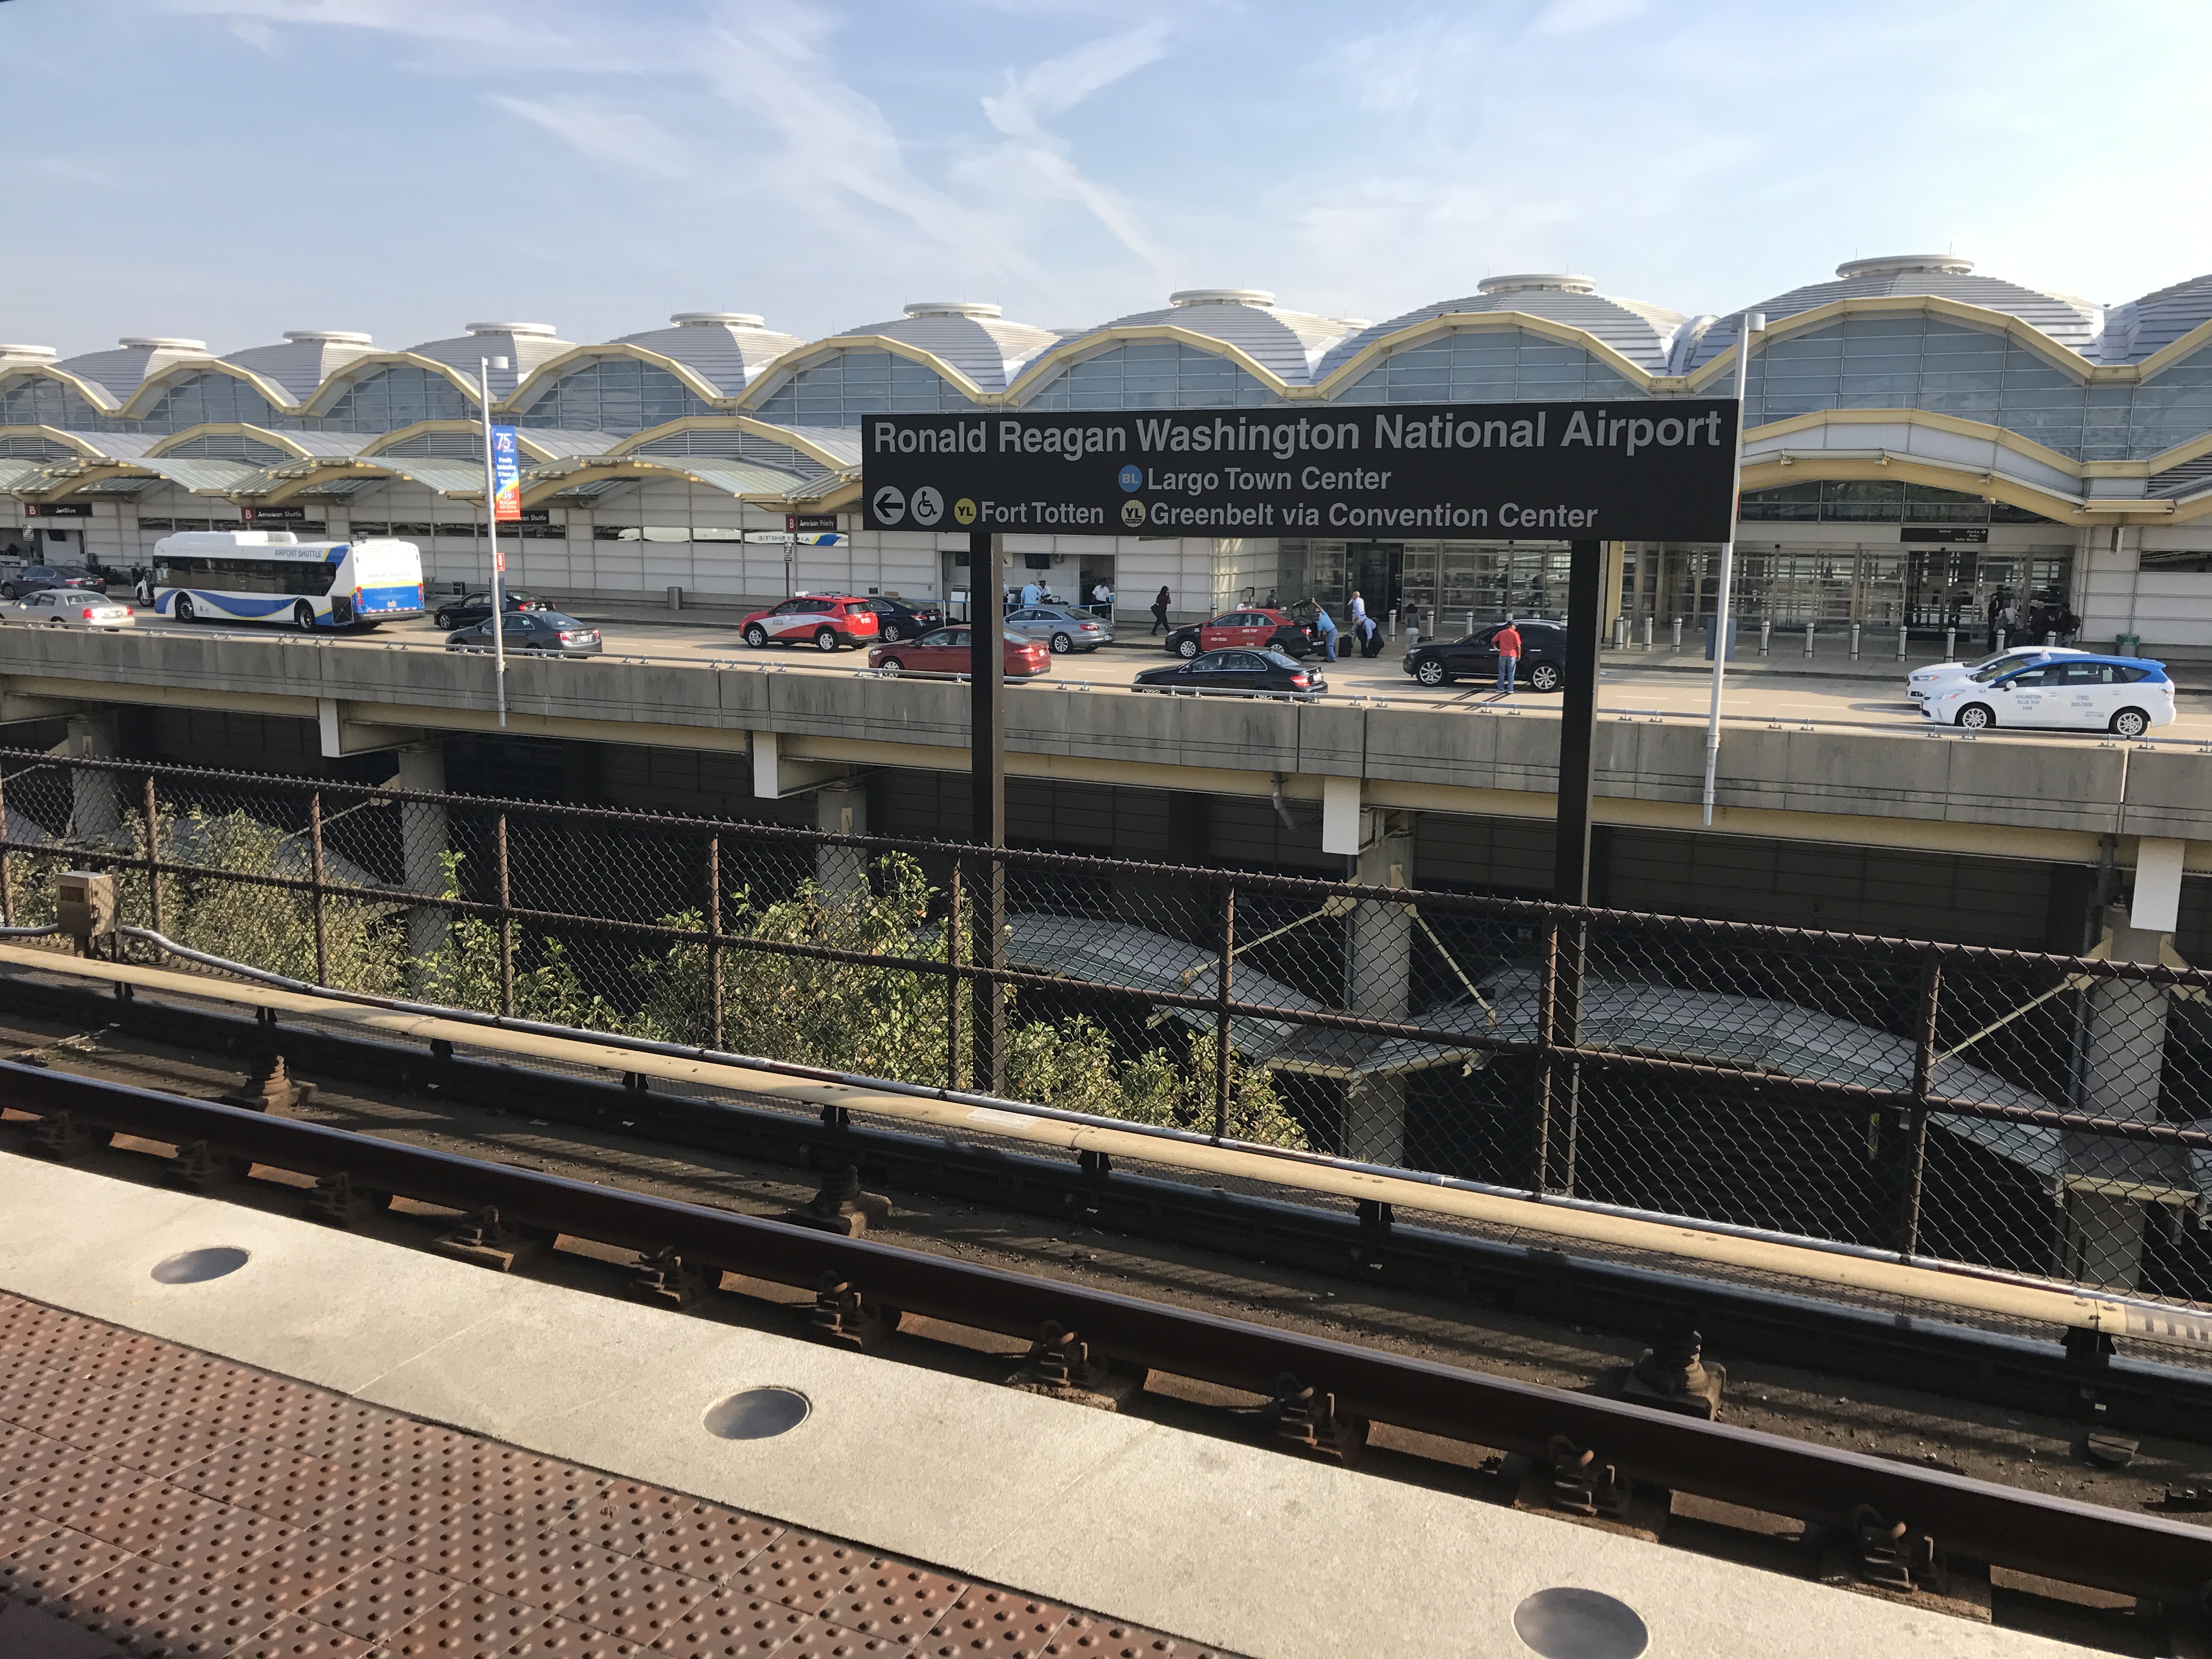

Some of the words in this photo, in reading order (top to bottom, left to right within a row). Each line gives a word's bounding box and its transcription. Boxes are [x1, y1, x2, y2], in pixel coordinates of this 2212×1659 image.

[496, 433, 512, 449] 75
[876, 421, 986, 453] Ronald
[1000, 421, 1125, 461] Reagan
[1136, 417, 1359, 460] Washington
[1375, 411, 1545, 449] National
[1560, 410, 1722, 456] Airport
[1122, 473, 1139, 484] BL
[1148, 468, 1219, 496] Largo
[1225, 468, 1291, 490] Town
[1302, 467, 1391, 490] Center
[29, 506, 36, 515] B
[245, 509, 252, 519] B
[958, 506, 973, 516] YL
[982, 501, 1027, 523] Fort
[1032, 502, 1103, 524] Totten
[1125, 507, 1142, 518] YL
[1151, 503, 1274, 526] Greenbelt
[1282, 503, 1319, 526] via
[1329, 503, 1488, 527] Convention
[1499, 503, 1598, 528] Center
[789, 518, 794, 529] B
[275, 549, 297, 557] AIRPORT
